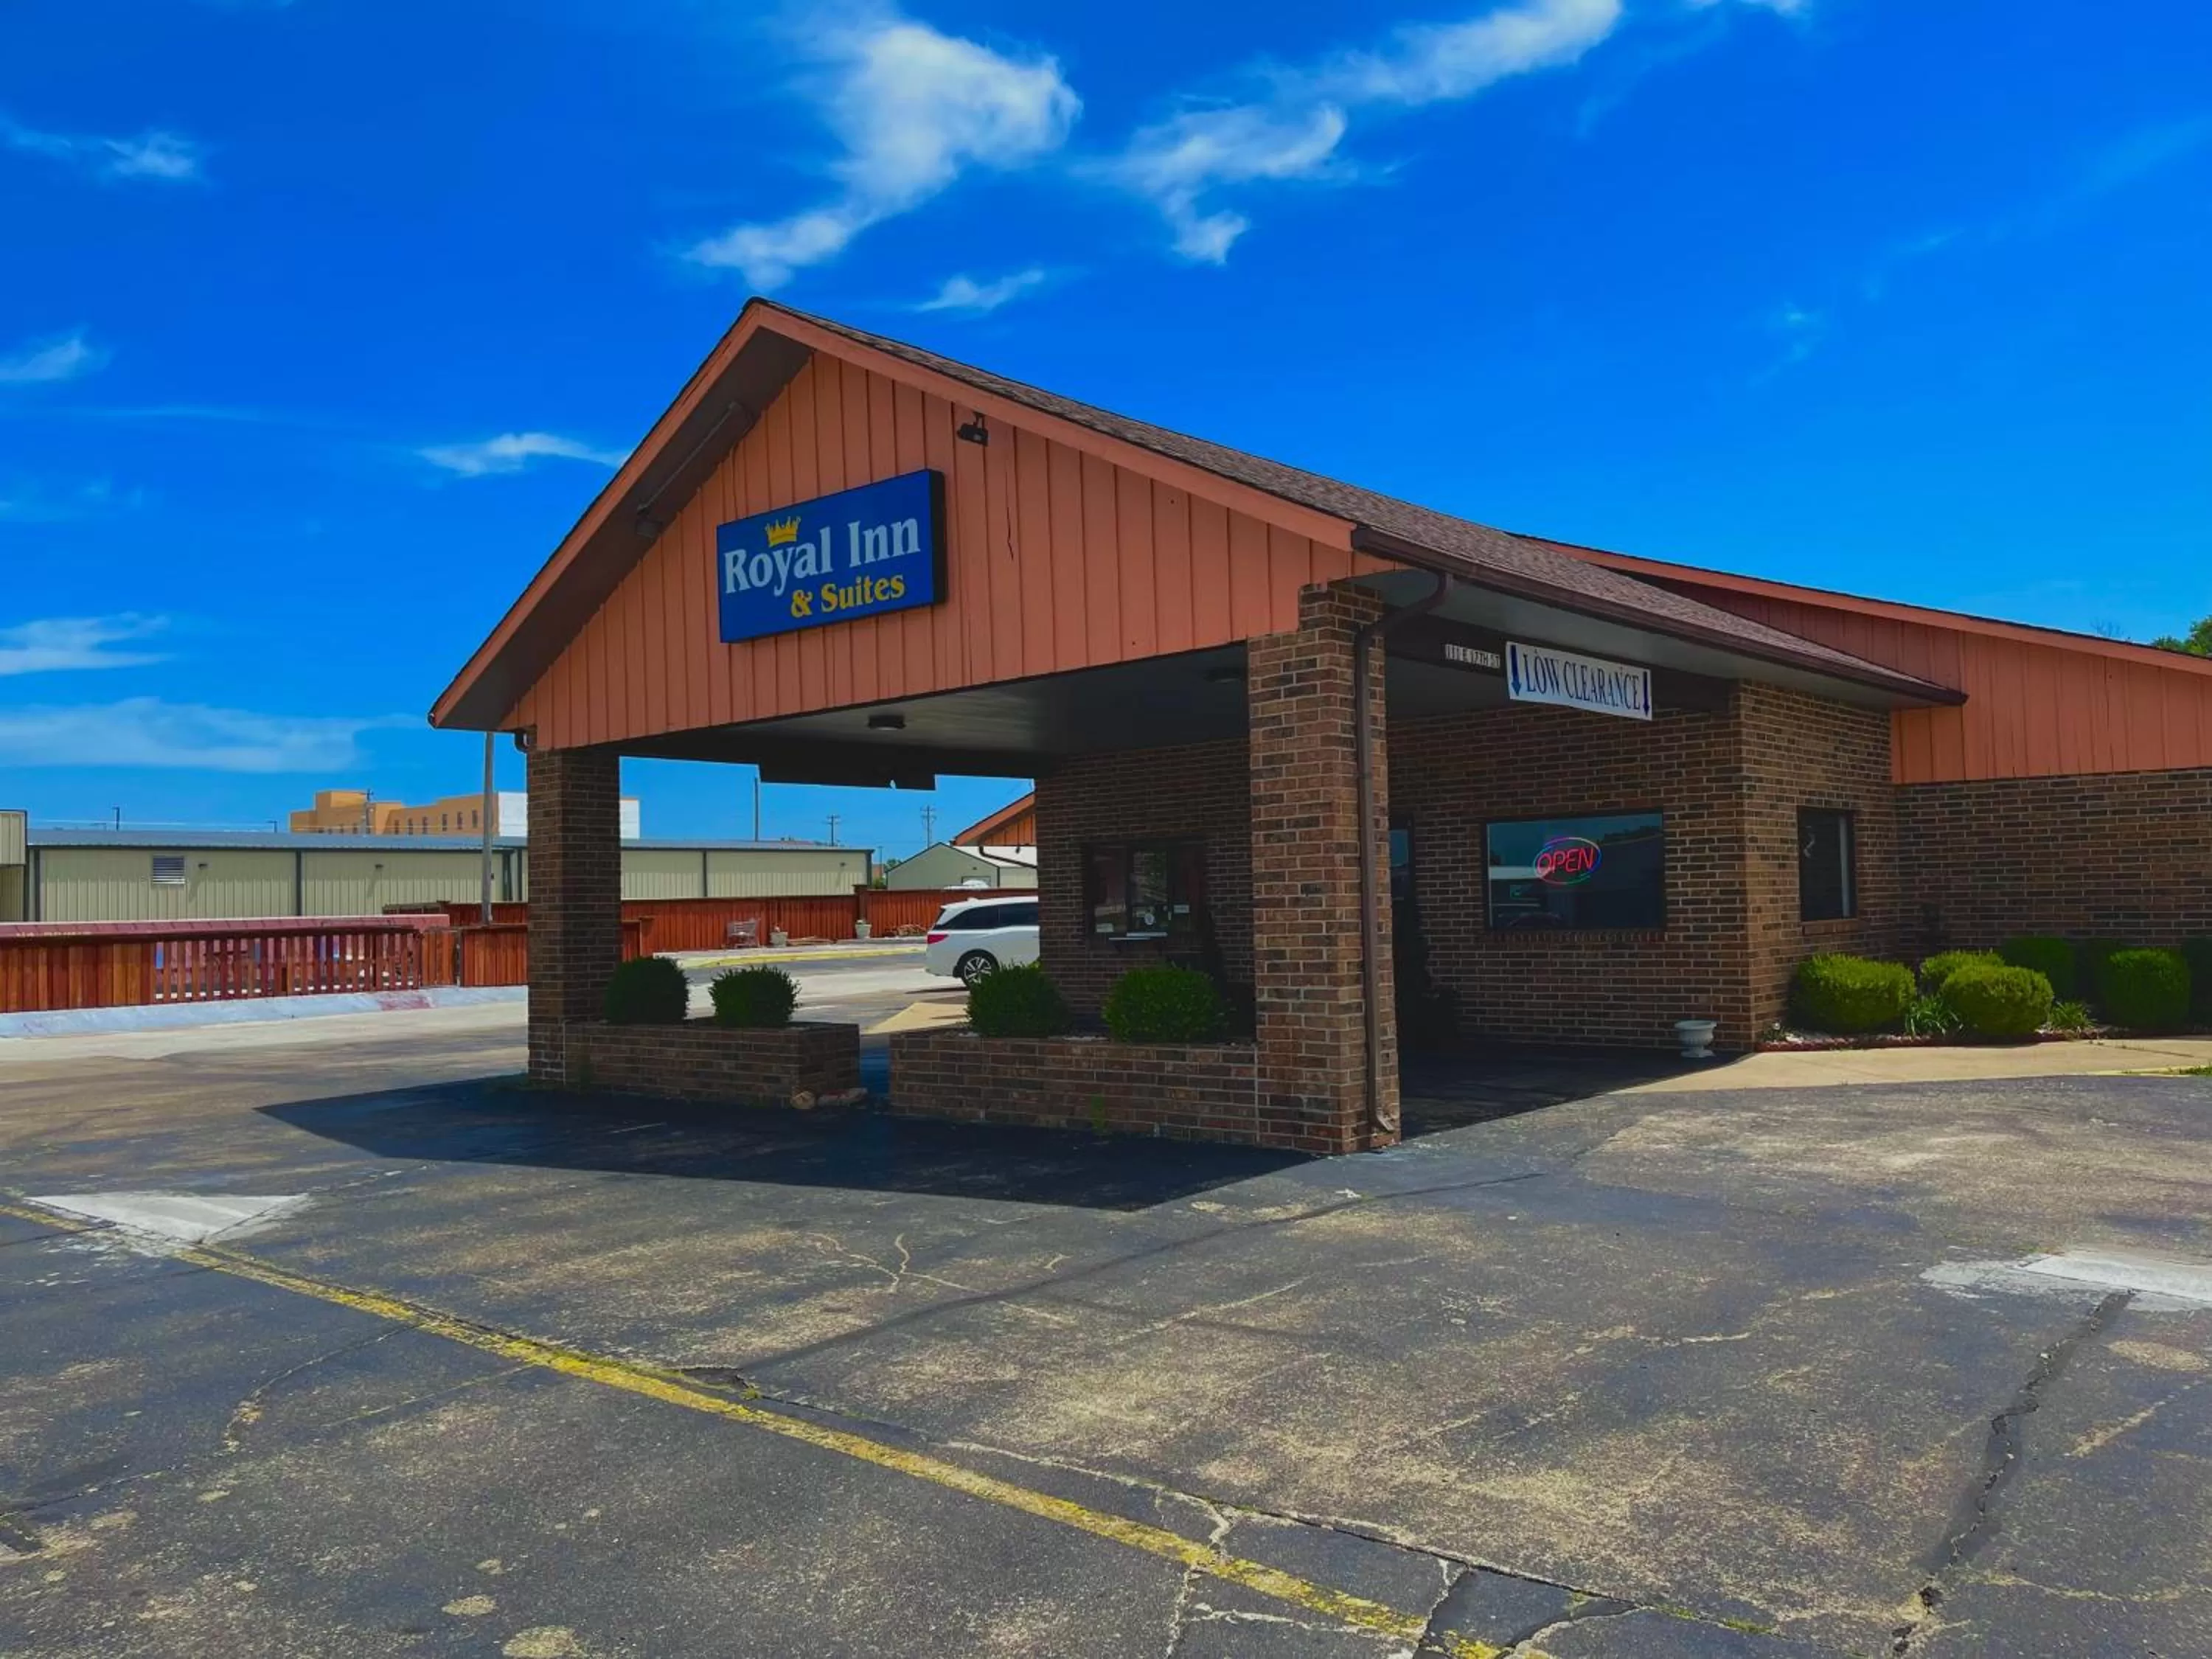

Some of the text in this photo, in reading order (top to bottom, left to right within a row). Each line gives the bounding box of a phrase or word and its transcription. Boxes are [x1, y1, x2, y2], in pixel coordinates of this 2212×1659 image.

[724, 517, 920, 596] Royal Inn
[790, 574, 905, 618] & Suites
[1523, 653, 1562, 696] LOW
[1563, 661, 1641, 710] CLEARANCE
[1537, 846, 1594, 874] OPEN
